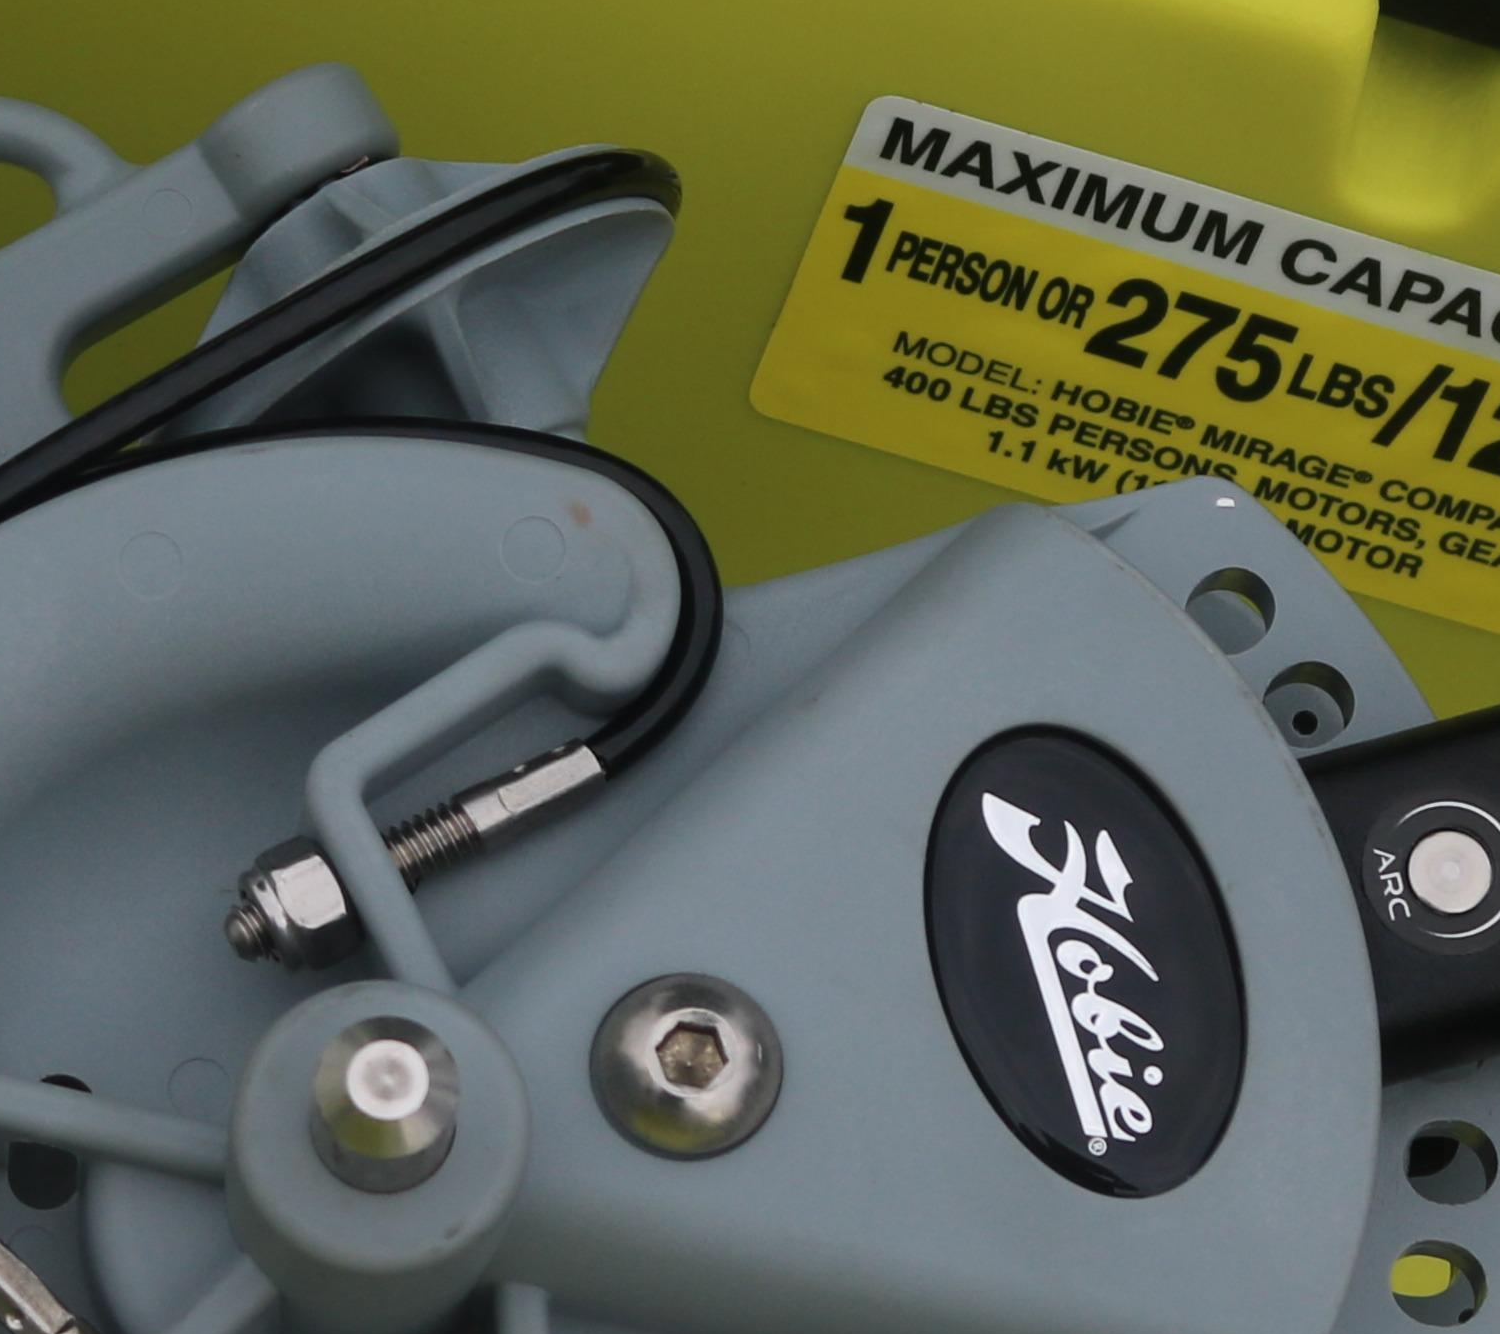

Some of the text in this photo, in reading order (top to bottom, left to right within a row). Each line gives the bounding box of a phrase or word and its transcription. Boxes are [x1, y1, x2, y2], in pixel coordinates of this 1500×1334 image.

[879, 117, 1265, 266] MAXIMUM
[841, 197, 894, 284] 1
[885, 230, 1039, 311] PERSON
[1037, 276, 1095, 329] OR
[893, 331, 1043, 395] MODEL:
[882, 365, 952, 402] 400
[959, 385, 1039, 428] LBS
[1252, 476, 1426, 551] MOTORS,
[987, 430, 1037, 463] 1.1
[1046, 448, 1110, 484] kW
[1286, 519, 1423, 578] MOTOR
[1372, 848, 1412, 921] ARC
